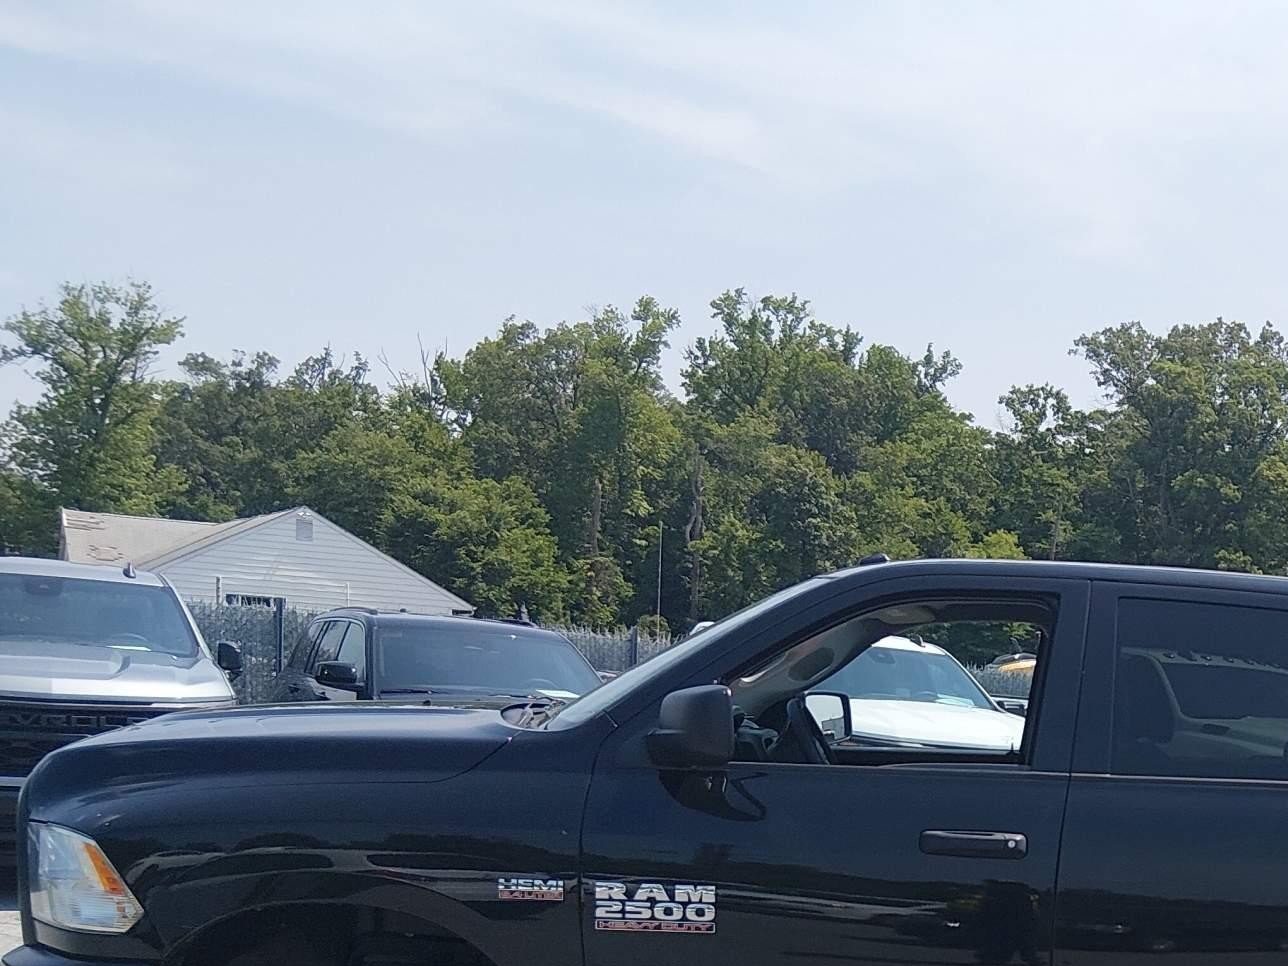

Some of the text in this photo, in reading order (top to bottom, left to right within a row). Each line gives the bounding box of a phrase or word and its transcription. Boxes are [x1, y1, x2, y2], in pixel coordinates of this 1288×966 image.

[498, 878, 564, 891] HEMI
[595, 882, 716, 902] RAM
[595, 901, 716, 921] 2500
[599, 920, 712, 932] HEAVY DUTY
